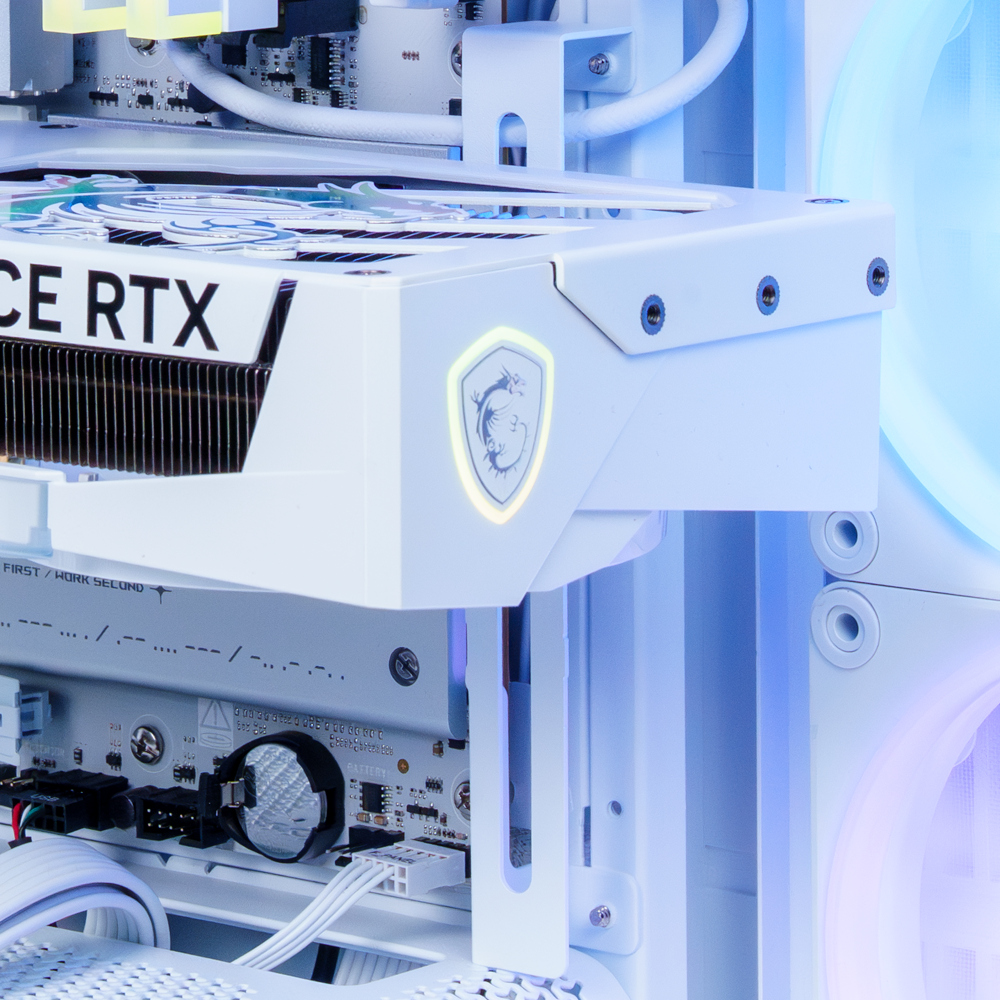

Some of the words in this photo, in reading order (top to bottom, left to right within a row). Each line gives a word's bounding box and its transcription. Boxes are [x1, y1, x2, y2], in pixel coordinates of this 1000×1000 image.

[87, 269, 220, 352] RTX
[4, 562, 41, 577] FIRST
[55, 571, 90, 585] WORK
